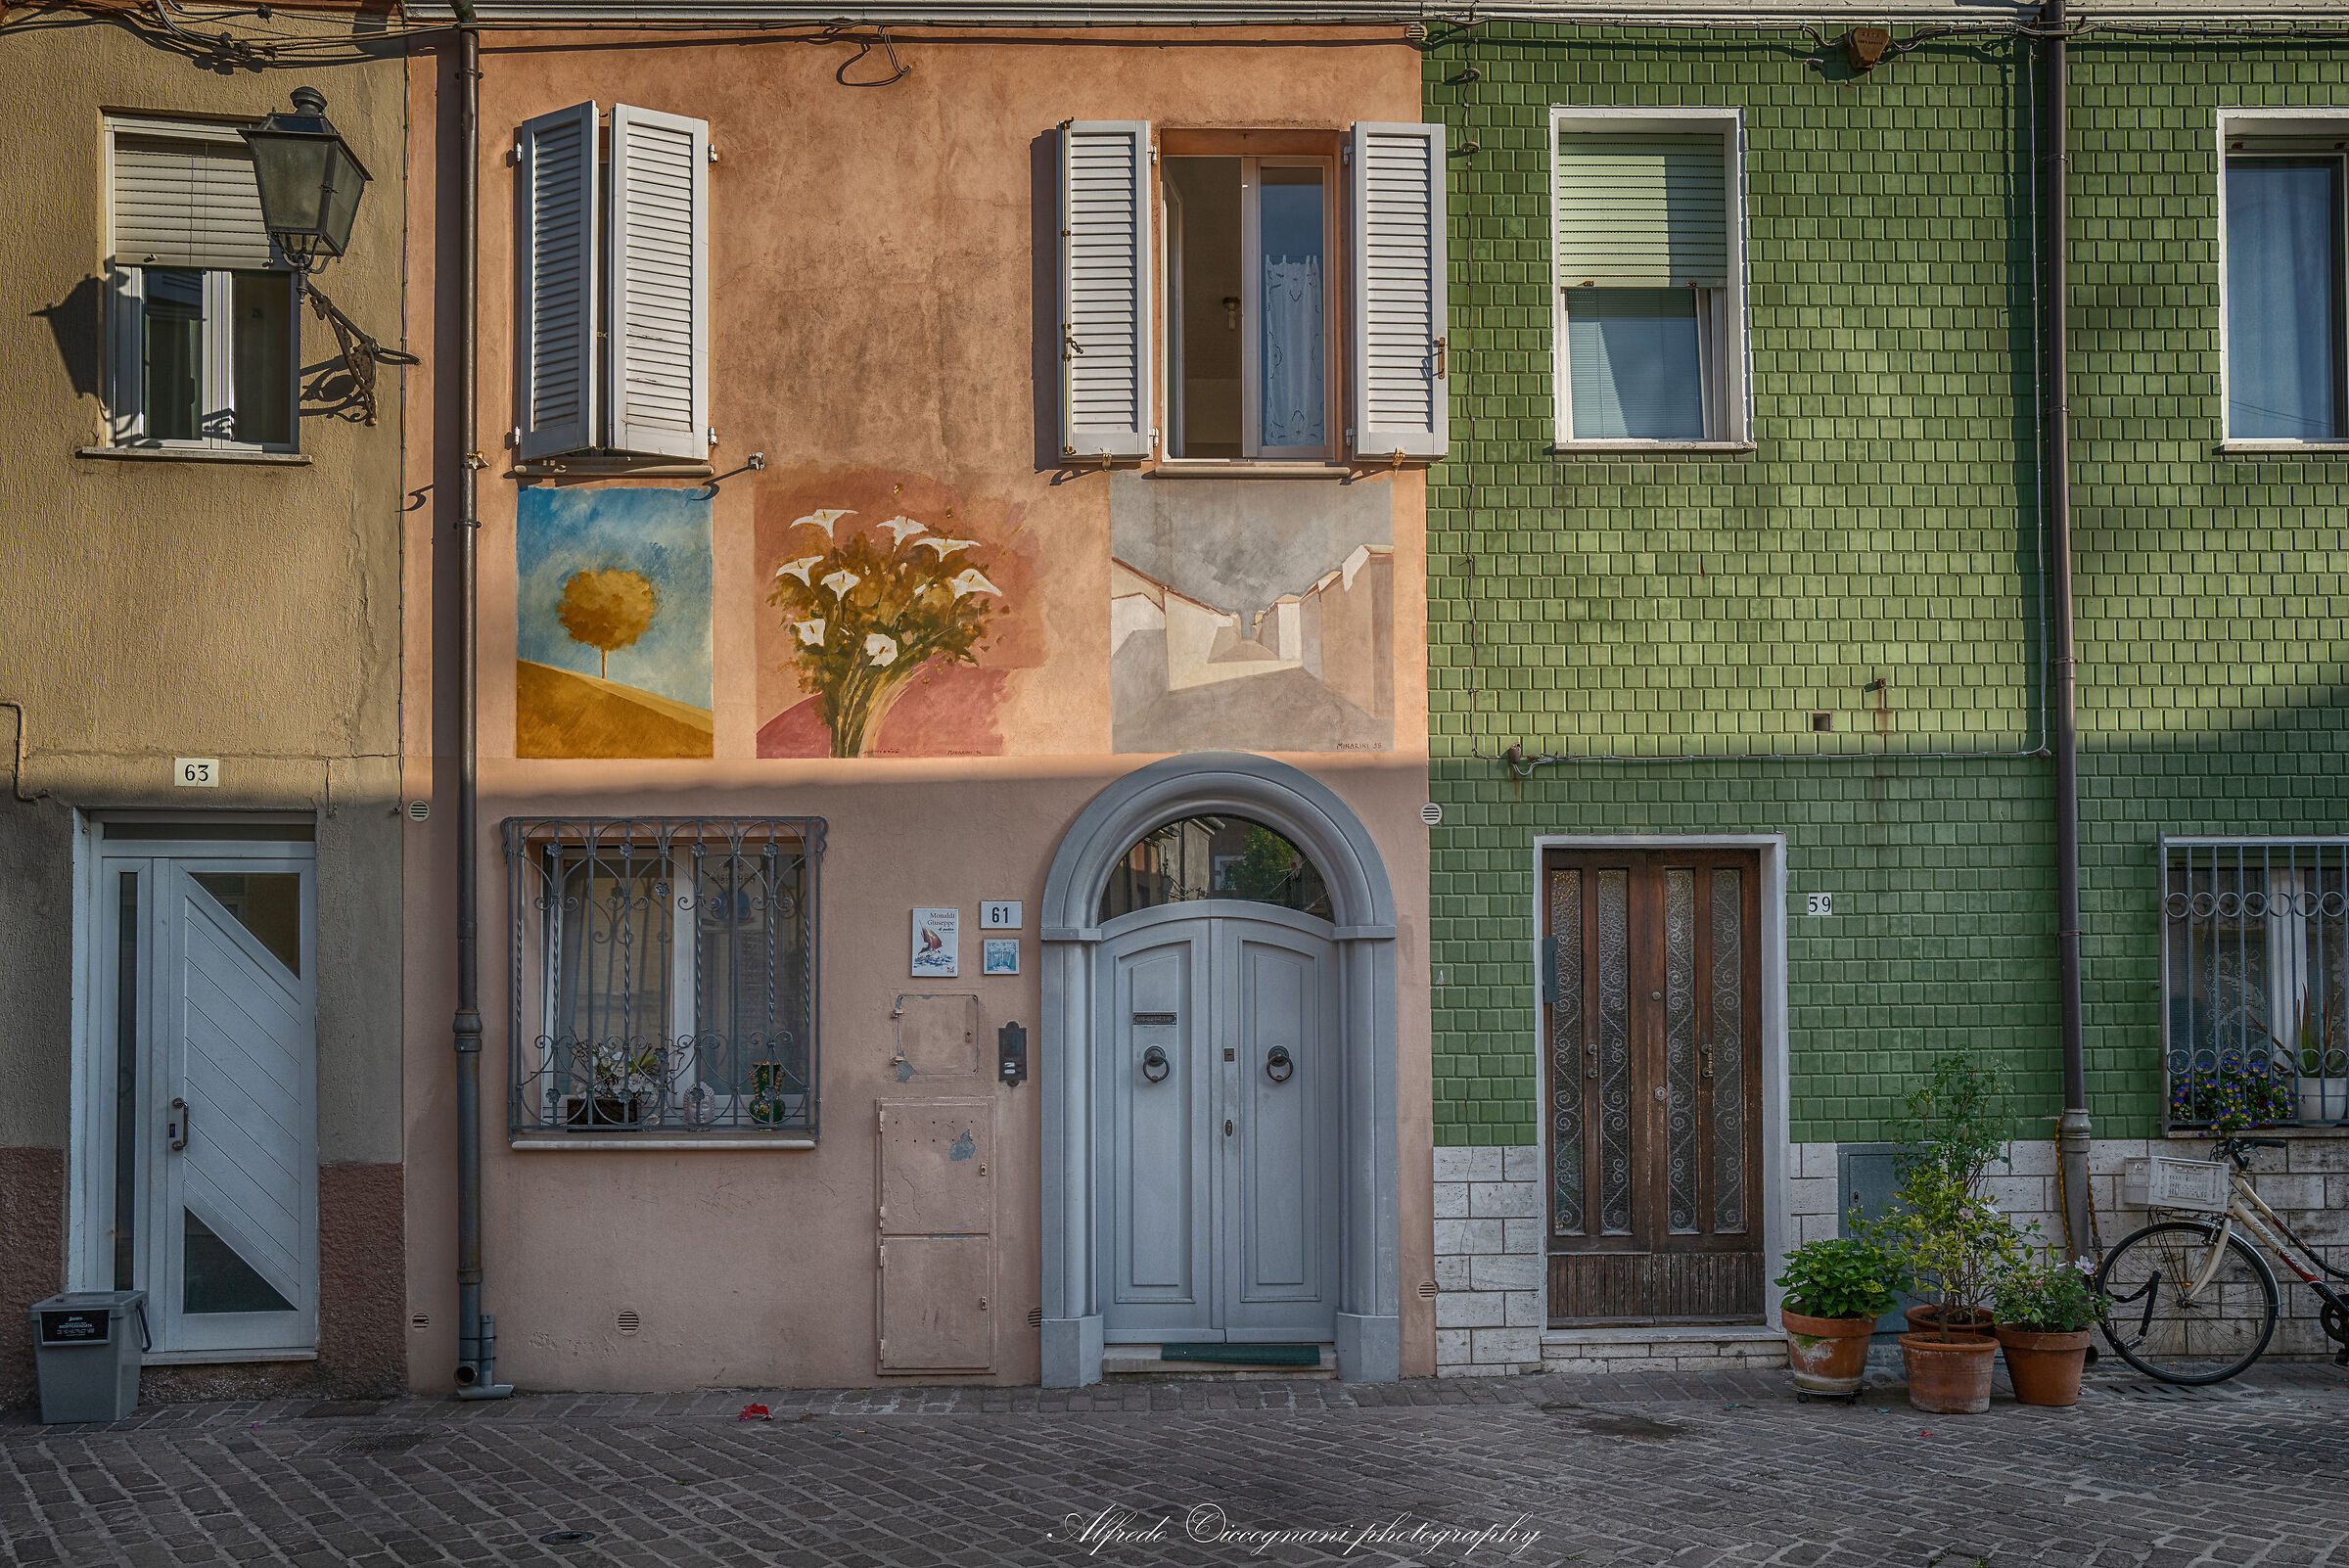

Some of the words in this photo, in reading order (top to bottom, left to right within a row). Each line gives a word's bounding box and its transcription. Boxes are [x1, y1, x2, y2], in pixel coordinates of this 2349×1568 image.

[185, 763, 209, 782] 63
[1809, 896, 1831, 913] 59
[991, 906, 1008, 924] 61
